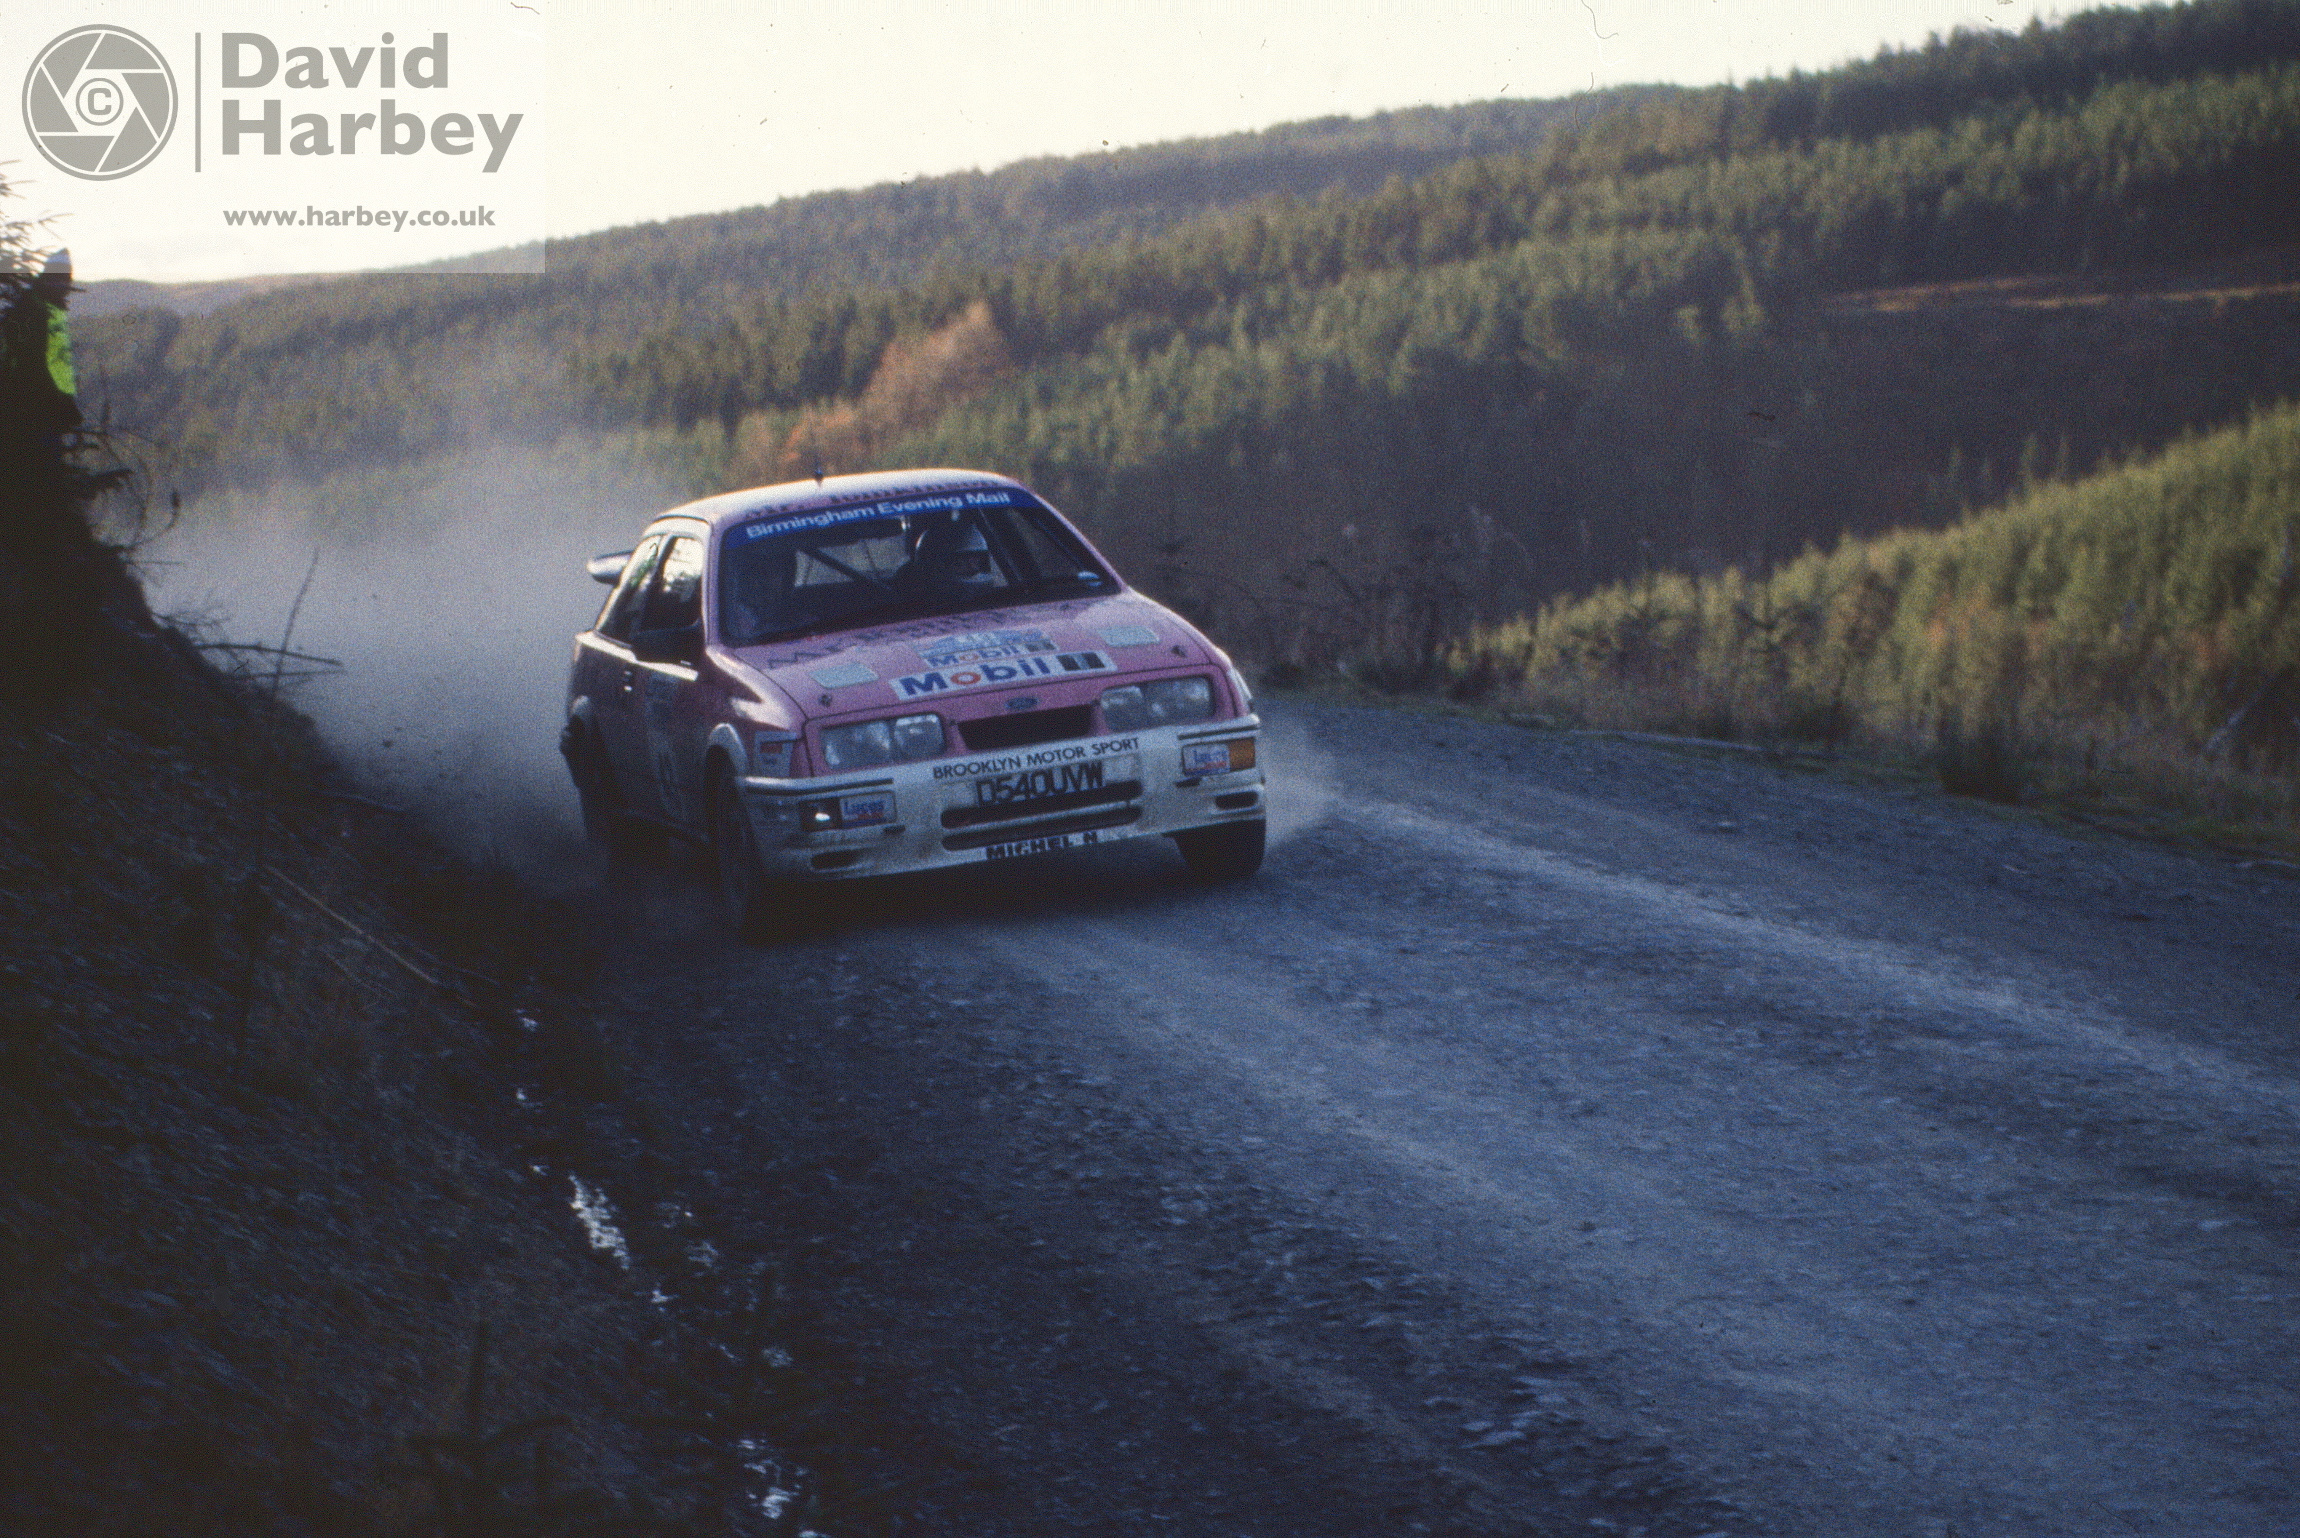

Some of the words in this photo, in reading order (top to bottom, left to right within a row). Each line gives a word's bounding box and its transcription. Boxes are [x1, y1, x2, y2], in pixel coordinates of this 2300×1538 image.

[746, 501, 875, 539] Birmingham
[877, 493, 963, 515] Evening
[965, 491, 1011, 506] Mail
[926, 641, 1020, 668] Mobil
[900, 656, 1051, 696] Mobil
[932, 755, 1022, 779] BROOKLYN
[1026, 746, 1086, 766] MOTOR
[1091, 737, 1140, 755] SPORT
